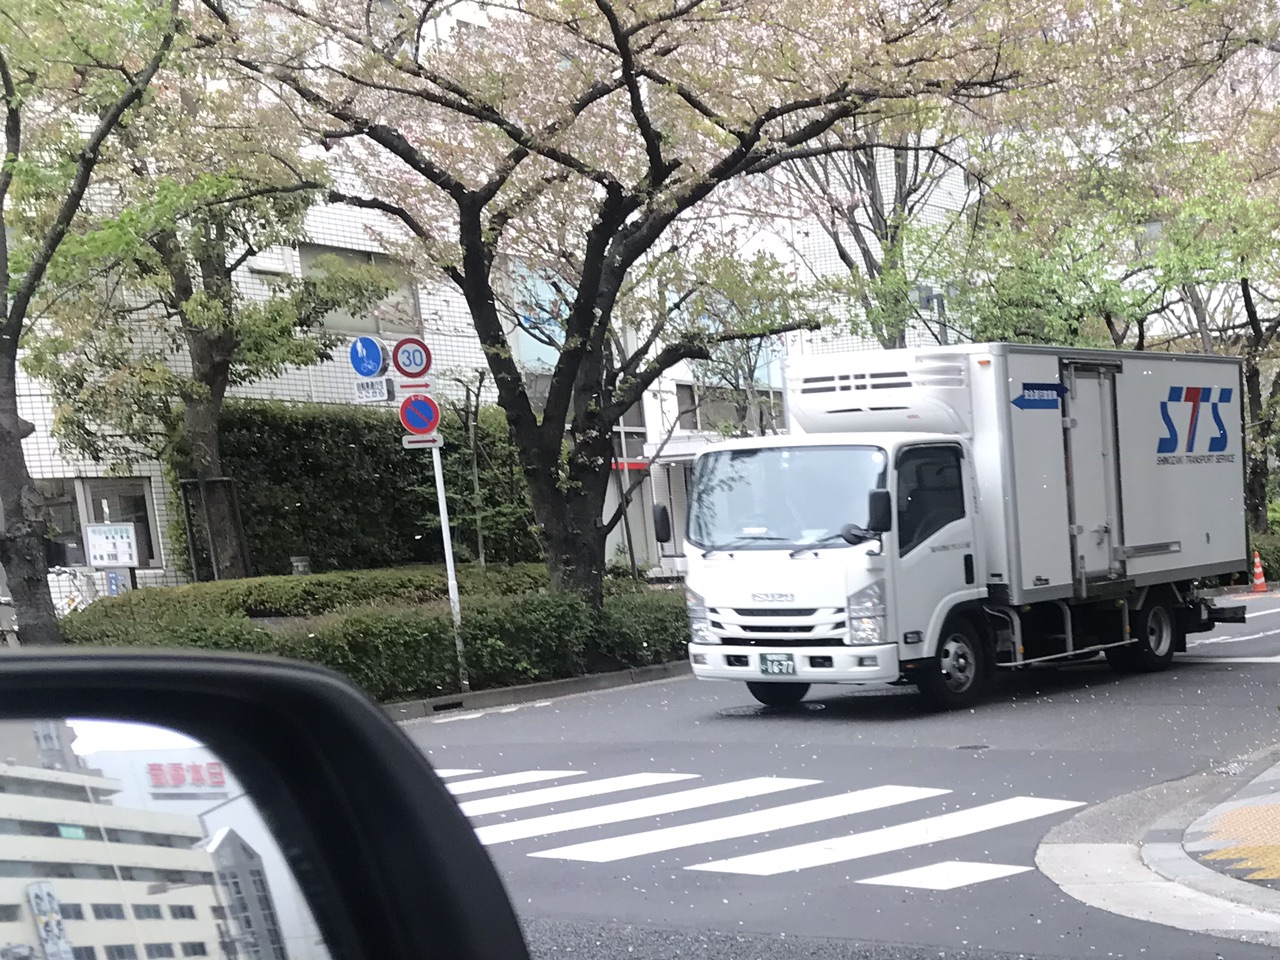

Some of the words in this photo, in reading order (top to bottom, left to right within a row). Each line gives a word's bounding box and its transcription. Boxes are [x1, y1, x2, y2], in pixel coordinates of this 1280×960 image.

[401, 349, 424, 367] 30
[1156, 386, 1234, 453] STS
[1184, 455, 1214, 464] TRANSPORT
[1215, 454, 1236, 464] SERVICE
[751, 593, 795, 603] ISUZU
